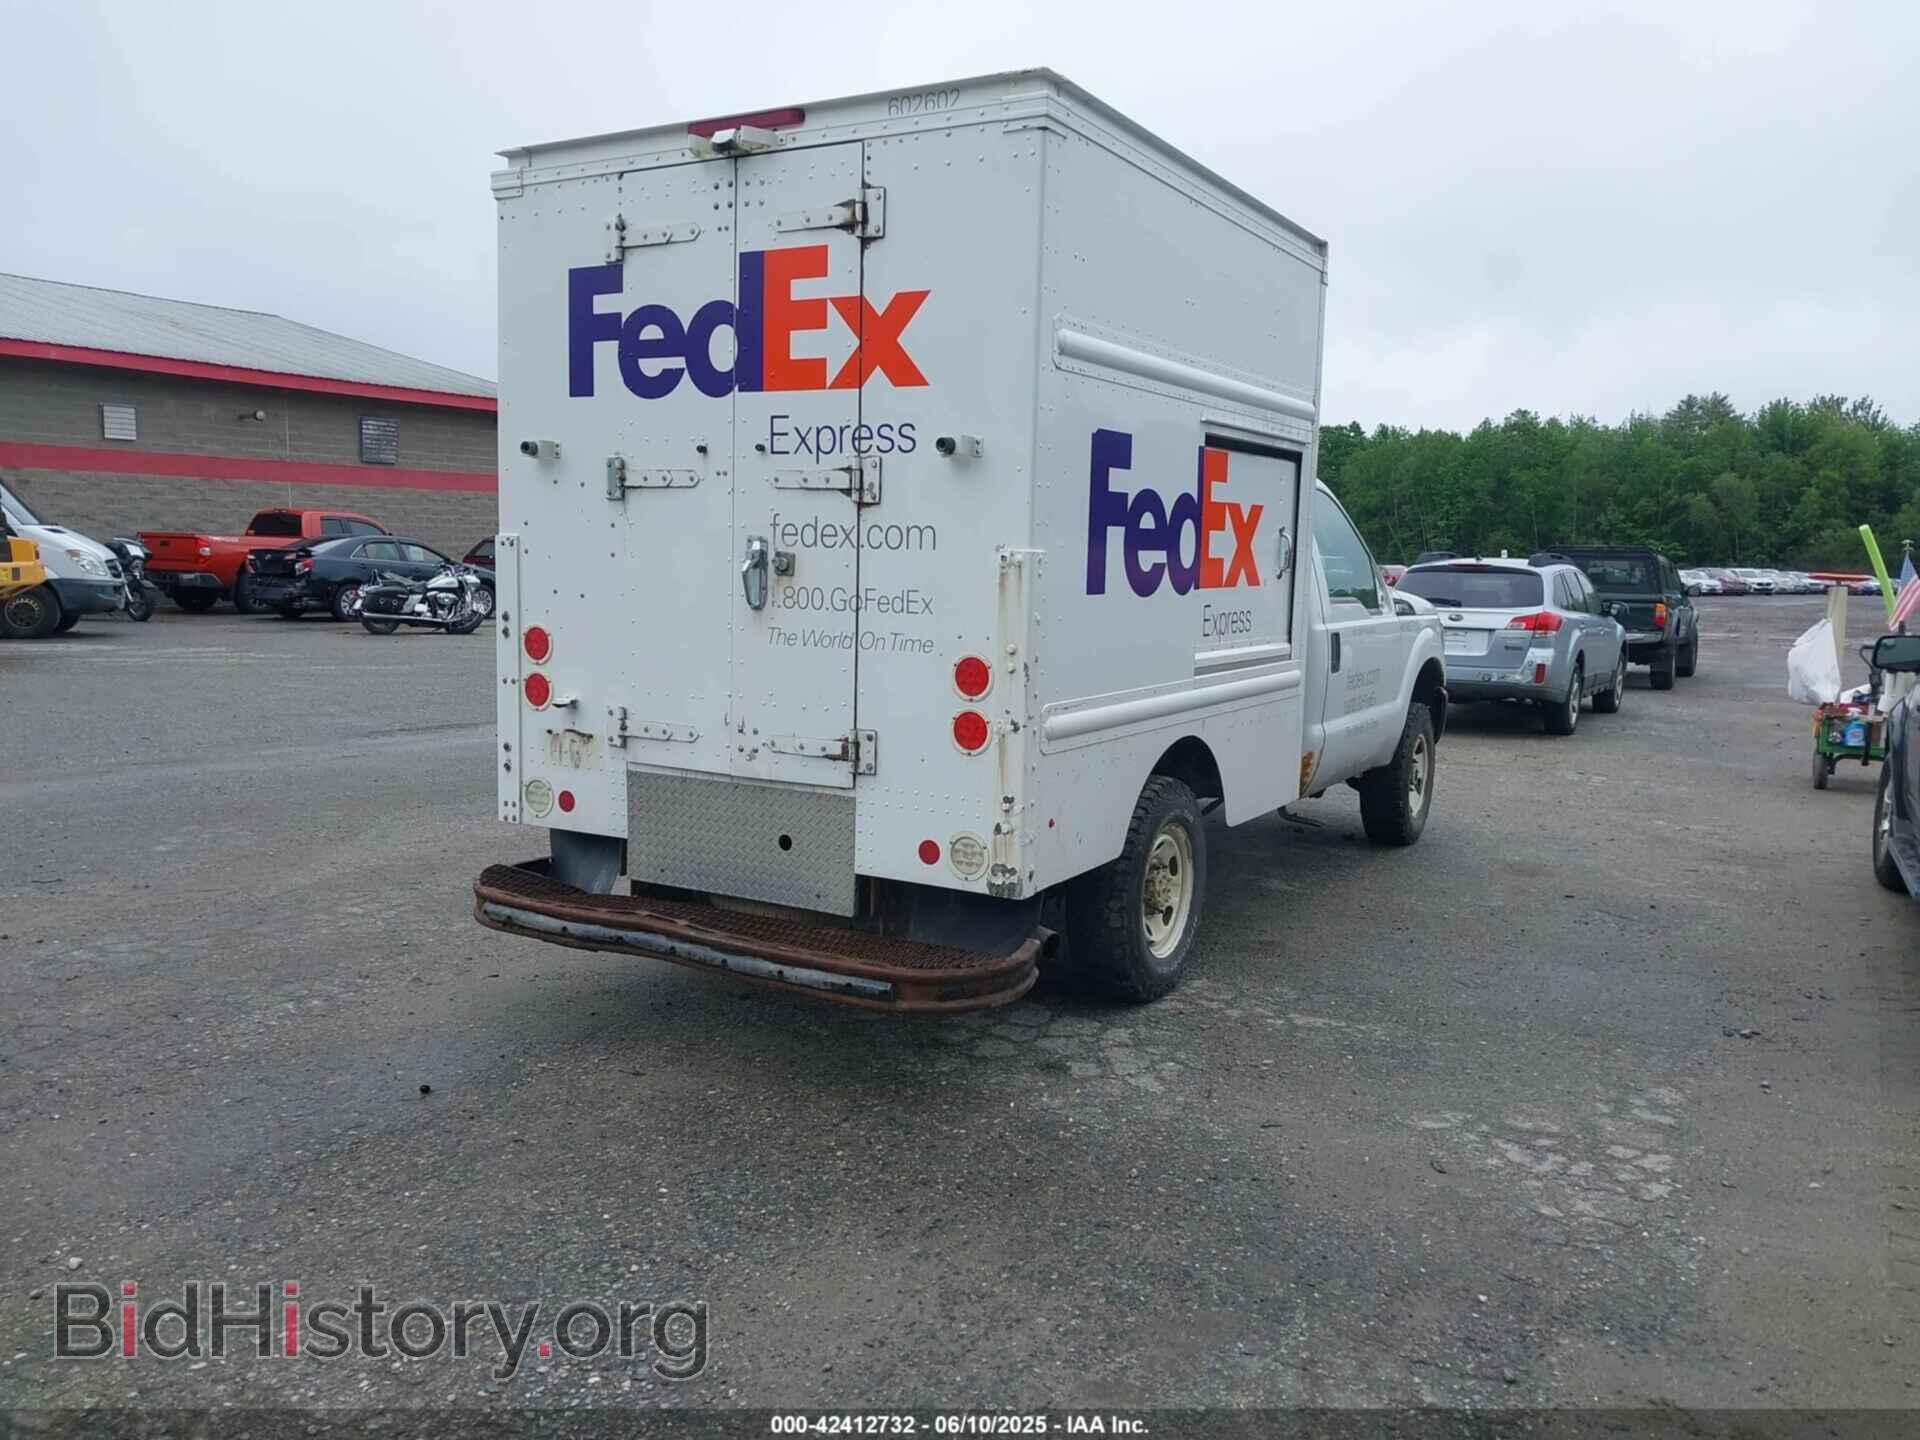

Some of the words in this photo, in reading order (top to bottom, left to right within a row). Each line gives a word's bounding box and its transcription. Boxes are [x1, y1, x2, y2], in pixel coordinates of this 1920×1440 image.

[568, 244, 932, 399] FedEx
[769, 415, 917, 464] Express
[769, 513, 937, 551] fedex.com
[1086, 428, 1263, 598] FedEx
[768, 626, 798, 646] The
[801, 629, 854, 650] World
[859, 631, 886, 650] On
[890, 632, 934, 654] Time
[1203, 604, 1252, 643] Express
